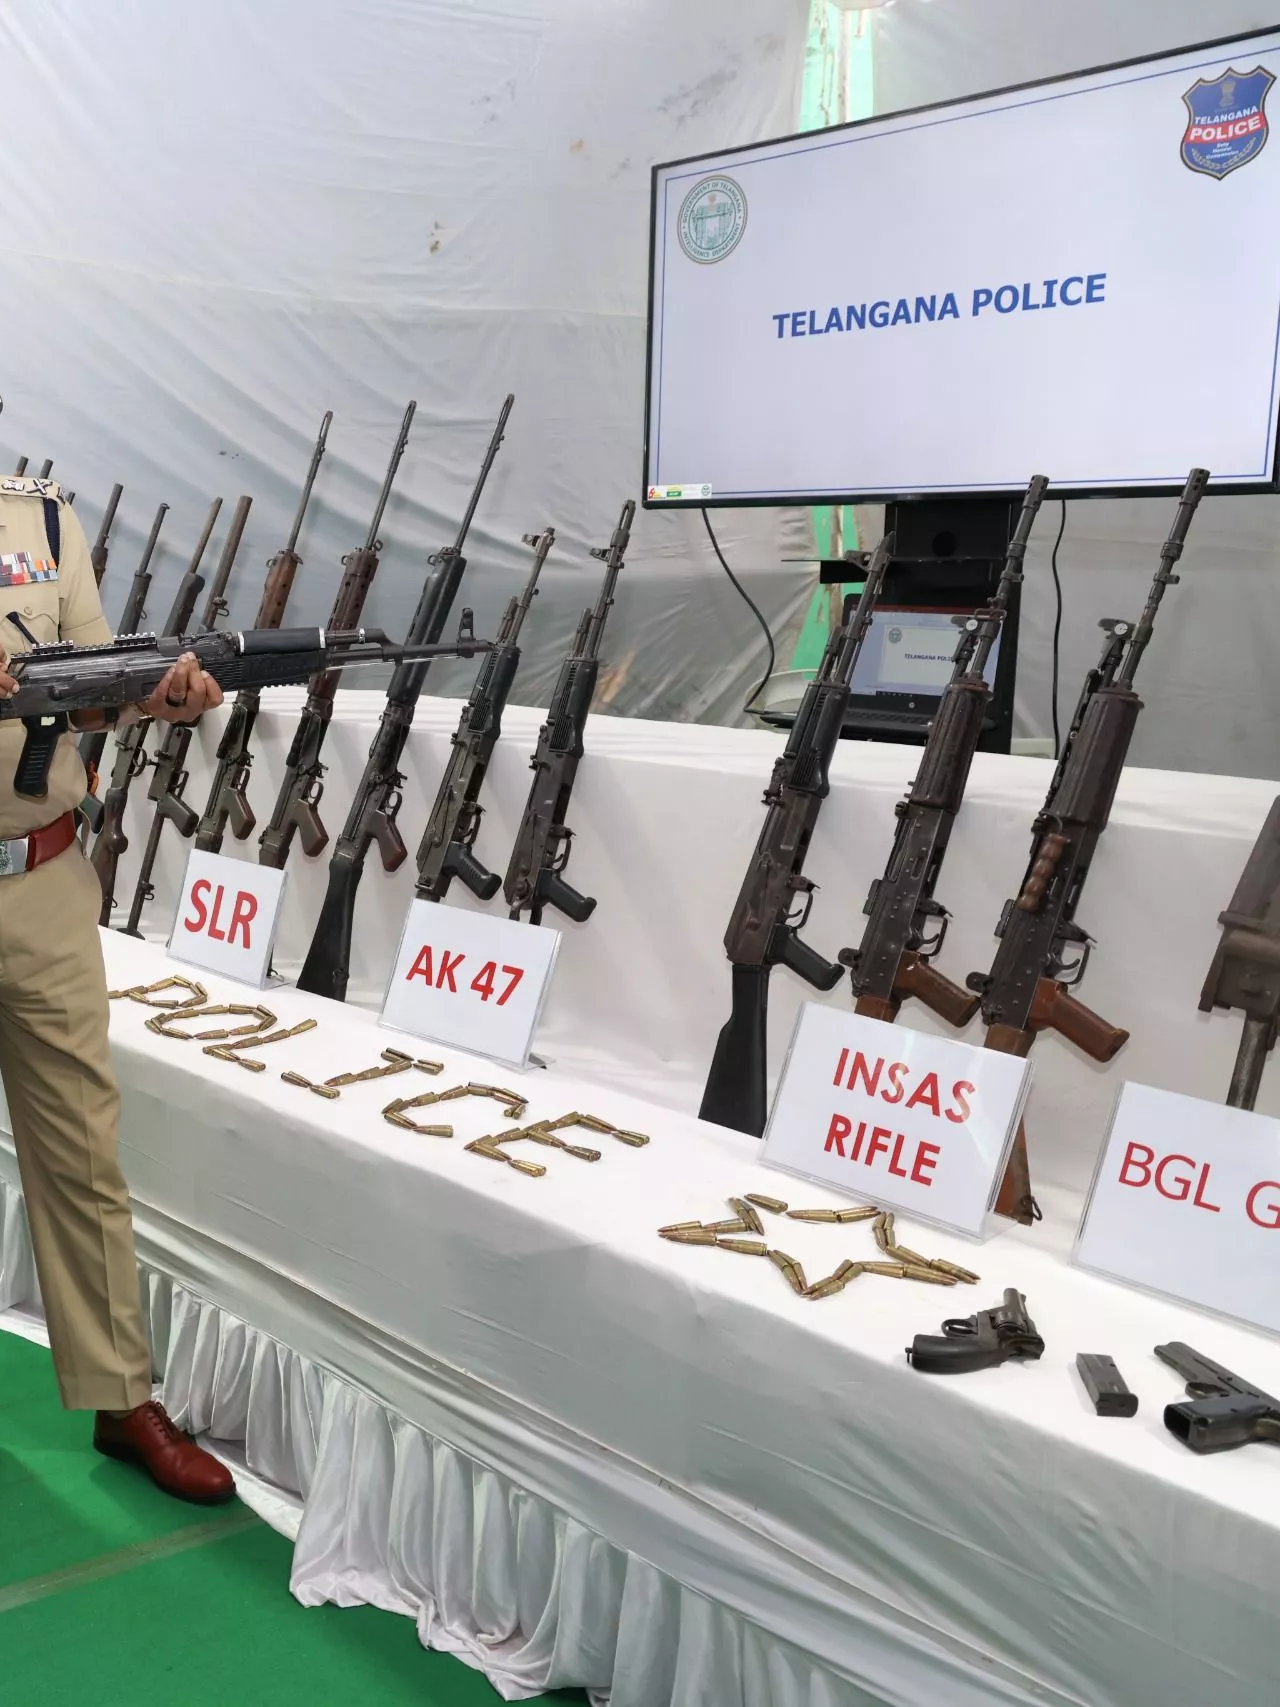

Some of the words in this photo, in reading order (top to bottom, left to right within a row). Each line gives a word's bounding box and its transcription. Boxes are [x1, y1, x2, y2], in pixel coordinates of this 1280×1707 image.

[1189, 115, 1262, 141] POLICE
[1194, 104, 1259, 125] TELANGANA
[772, 292, 961, 339] TELANGANA
[971, 273, 1107, 317] POLICE
[183, 878, 259, 950] SLR
[405, 944, 466, 994] AK
[470, 959, 525, 1006] 47
[832, 1046, 976, 1124] INSAS
[823, 1112, 942, 1188] RIFLE
[1117, 1140, 1222, 1214] BGL
